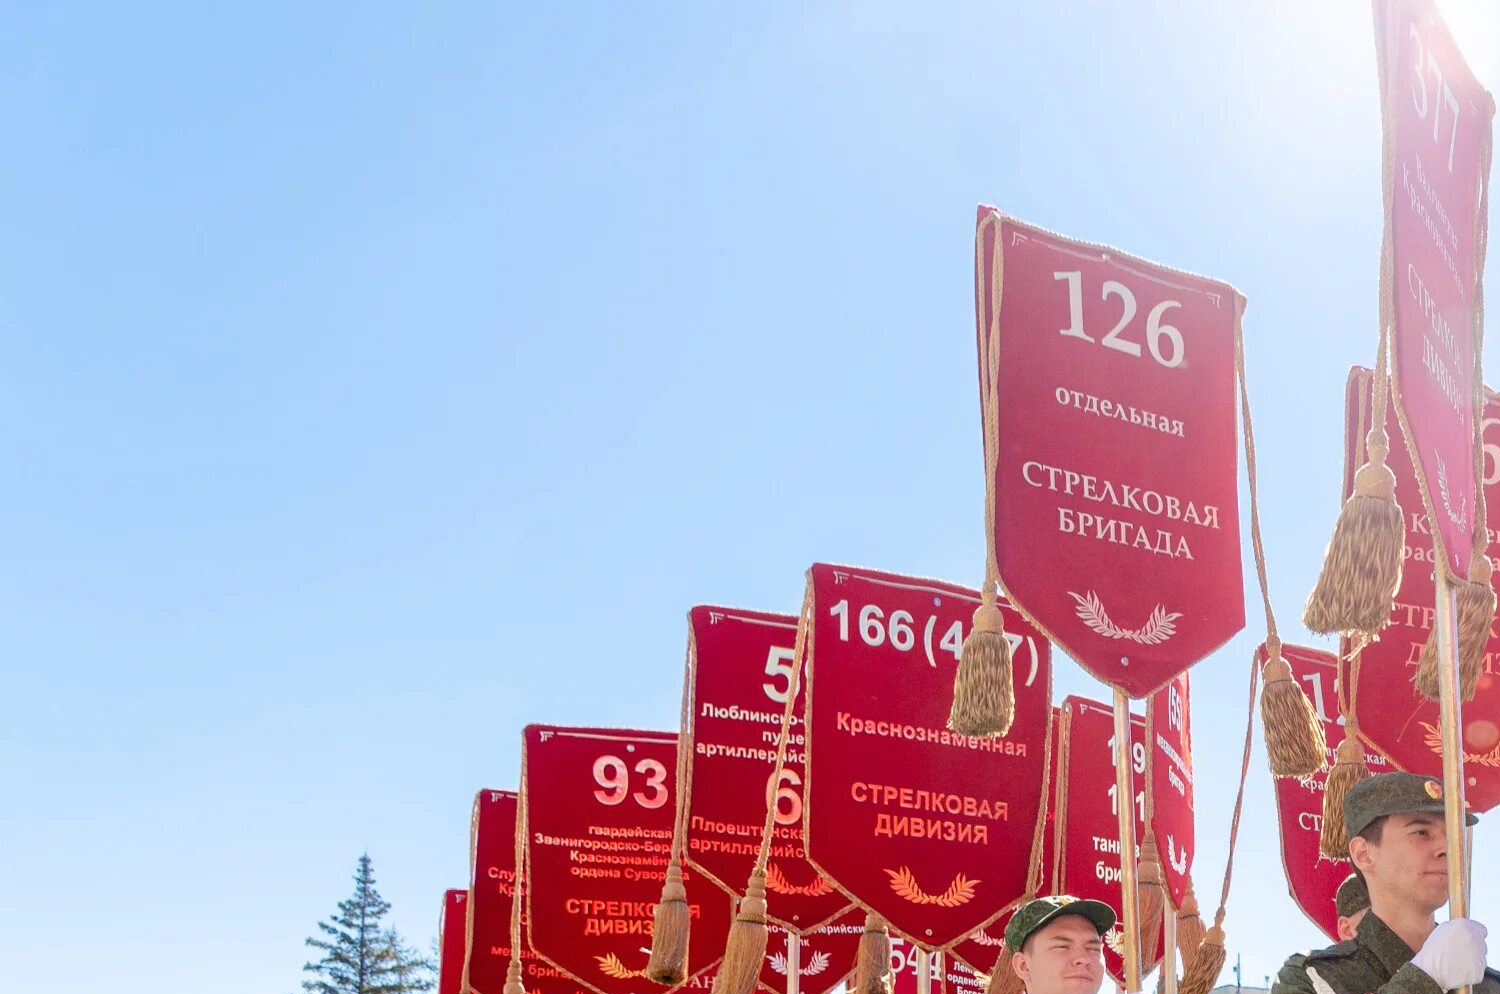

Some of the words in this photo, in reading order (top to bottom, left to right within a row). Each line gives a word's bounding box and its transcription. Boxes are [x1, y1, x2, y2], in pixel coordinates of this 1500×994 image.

[1053, 270, 1186, 369] 126
[1055, 386, 1185, 438] отдельная
[1022, 461, 1220, 530] СТРЕЛКОВАЯ
[1057, 507, 1194, 560] БРИГАДА
[593, 755, 669, 809] 93
[851, 781, 1008, 821] СТРЕЛКОВАЯ
[588, 825, 673, 839] гвардейская
[875, 813, 988, 845] ДИВИЗИЯ
[571, 866, 621, 879] ордена
